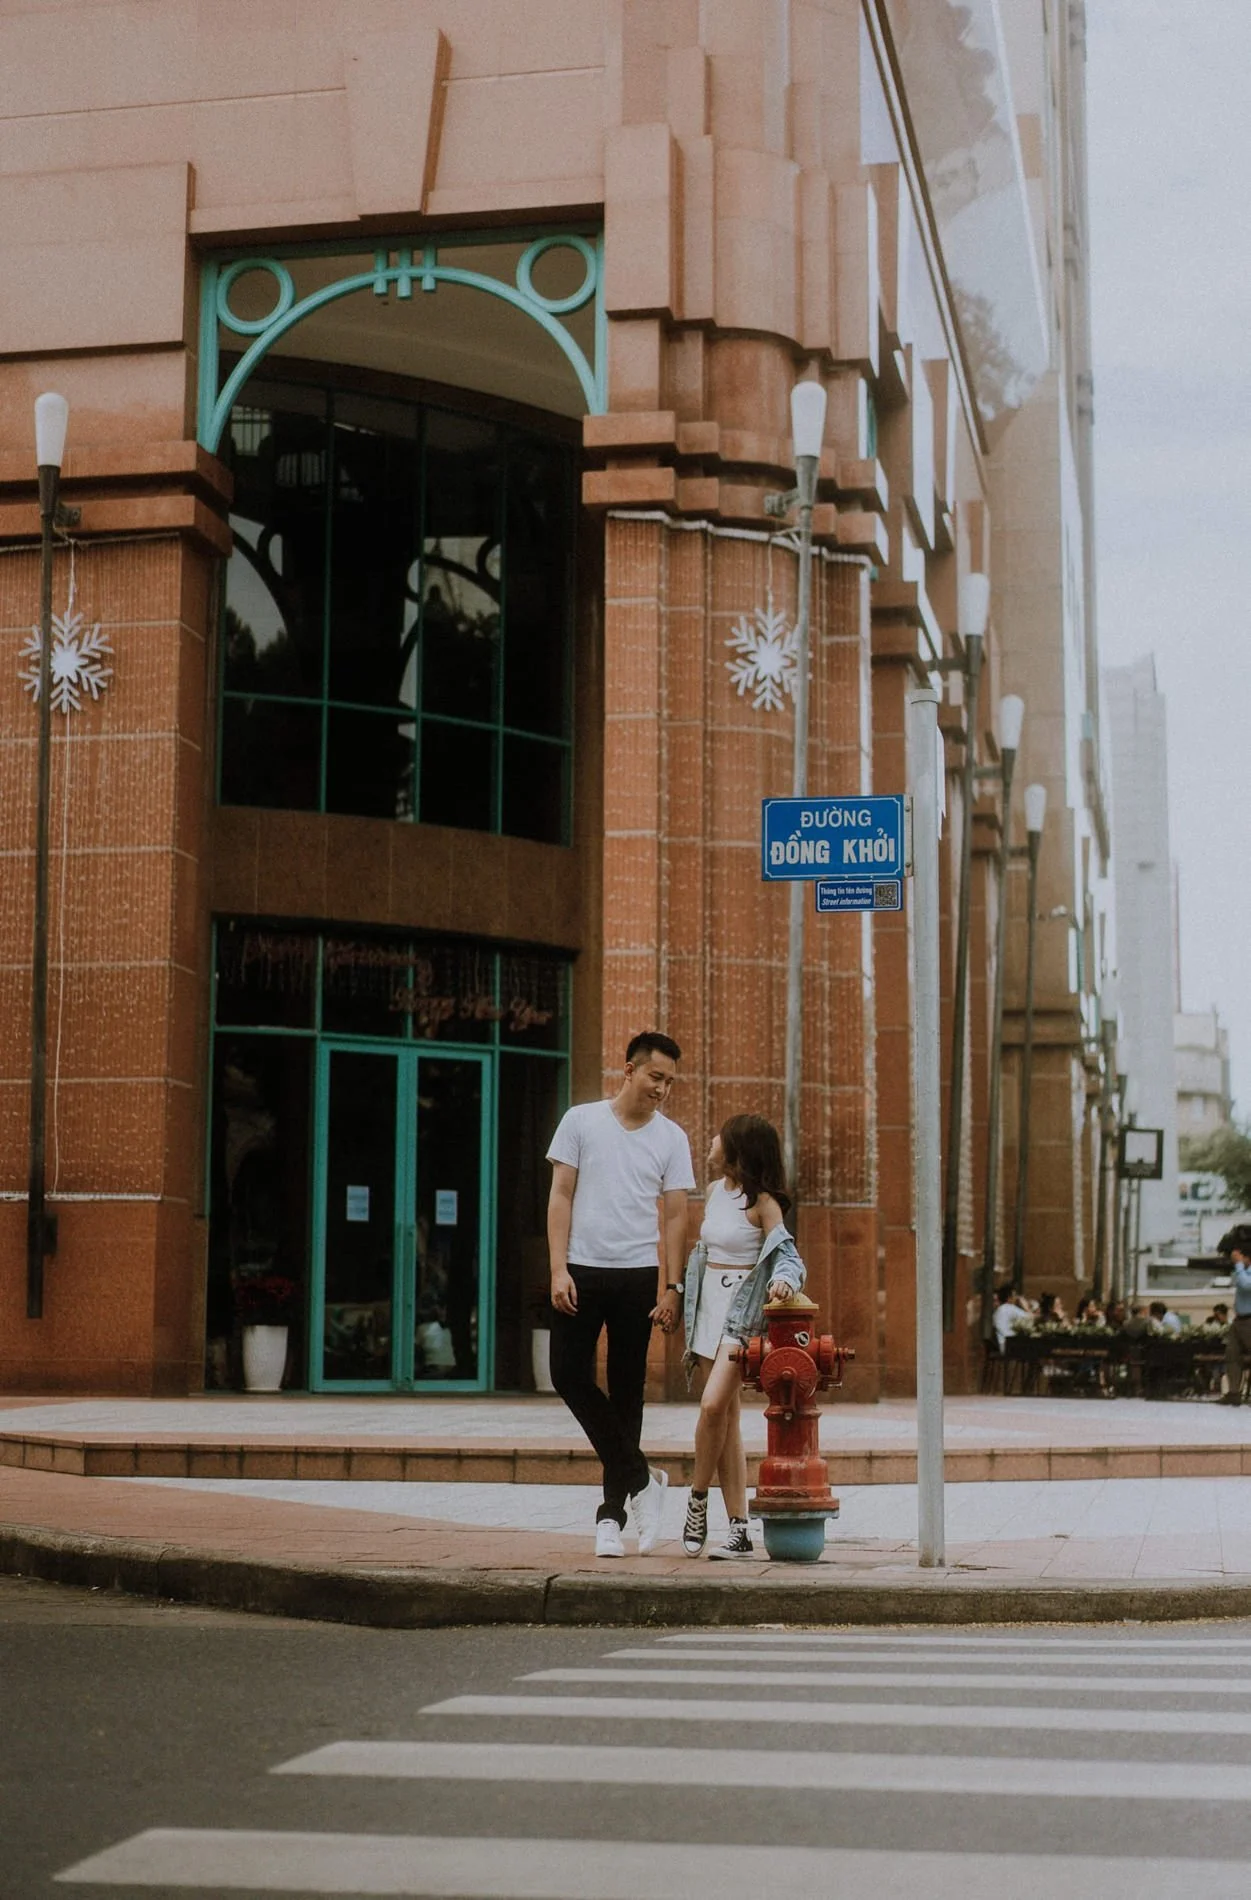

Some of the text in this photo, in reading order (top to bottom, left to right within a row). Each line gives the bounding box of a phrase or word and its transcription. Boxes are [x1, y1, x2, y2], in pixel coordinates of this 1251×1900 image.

[800, 806, 872, 828] ĐƯỜNG
[770, 827, 895, 865] ĐỒNG KHỞI
[822, 897, 871, 906] Street information
